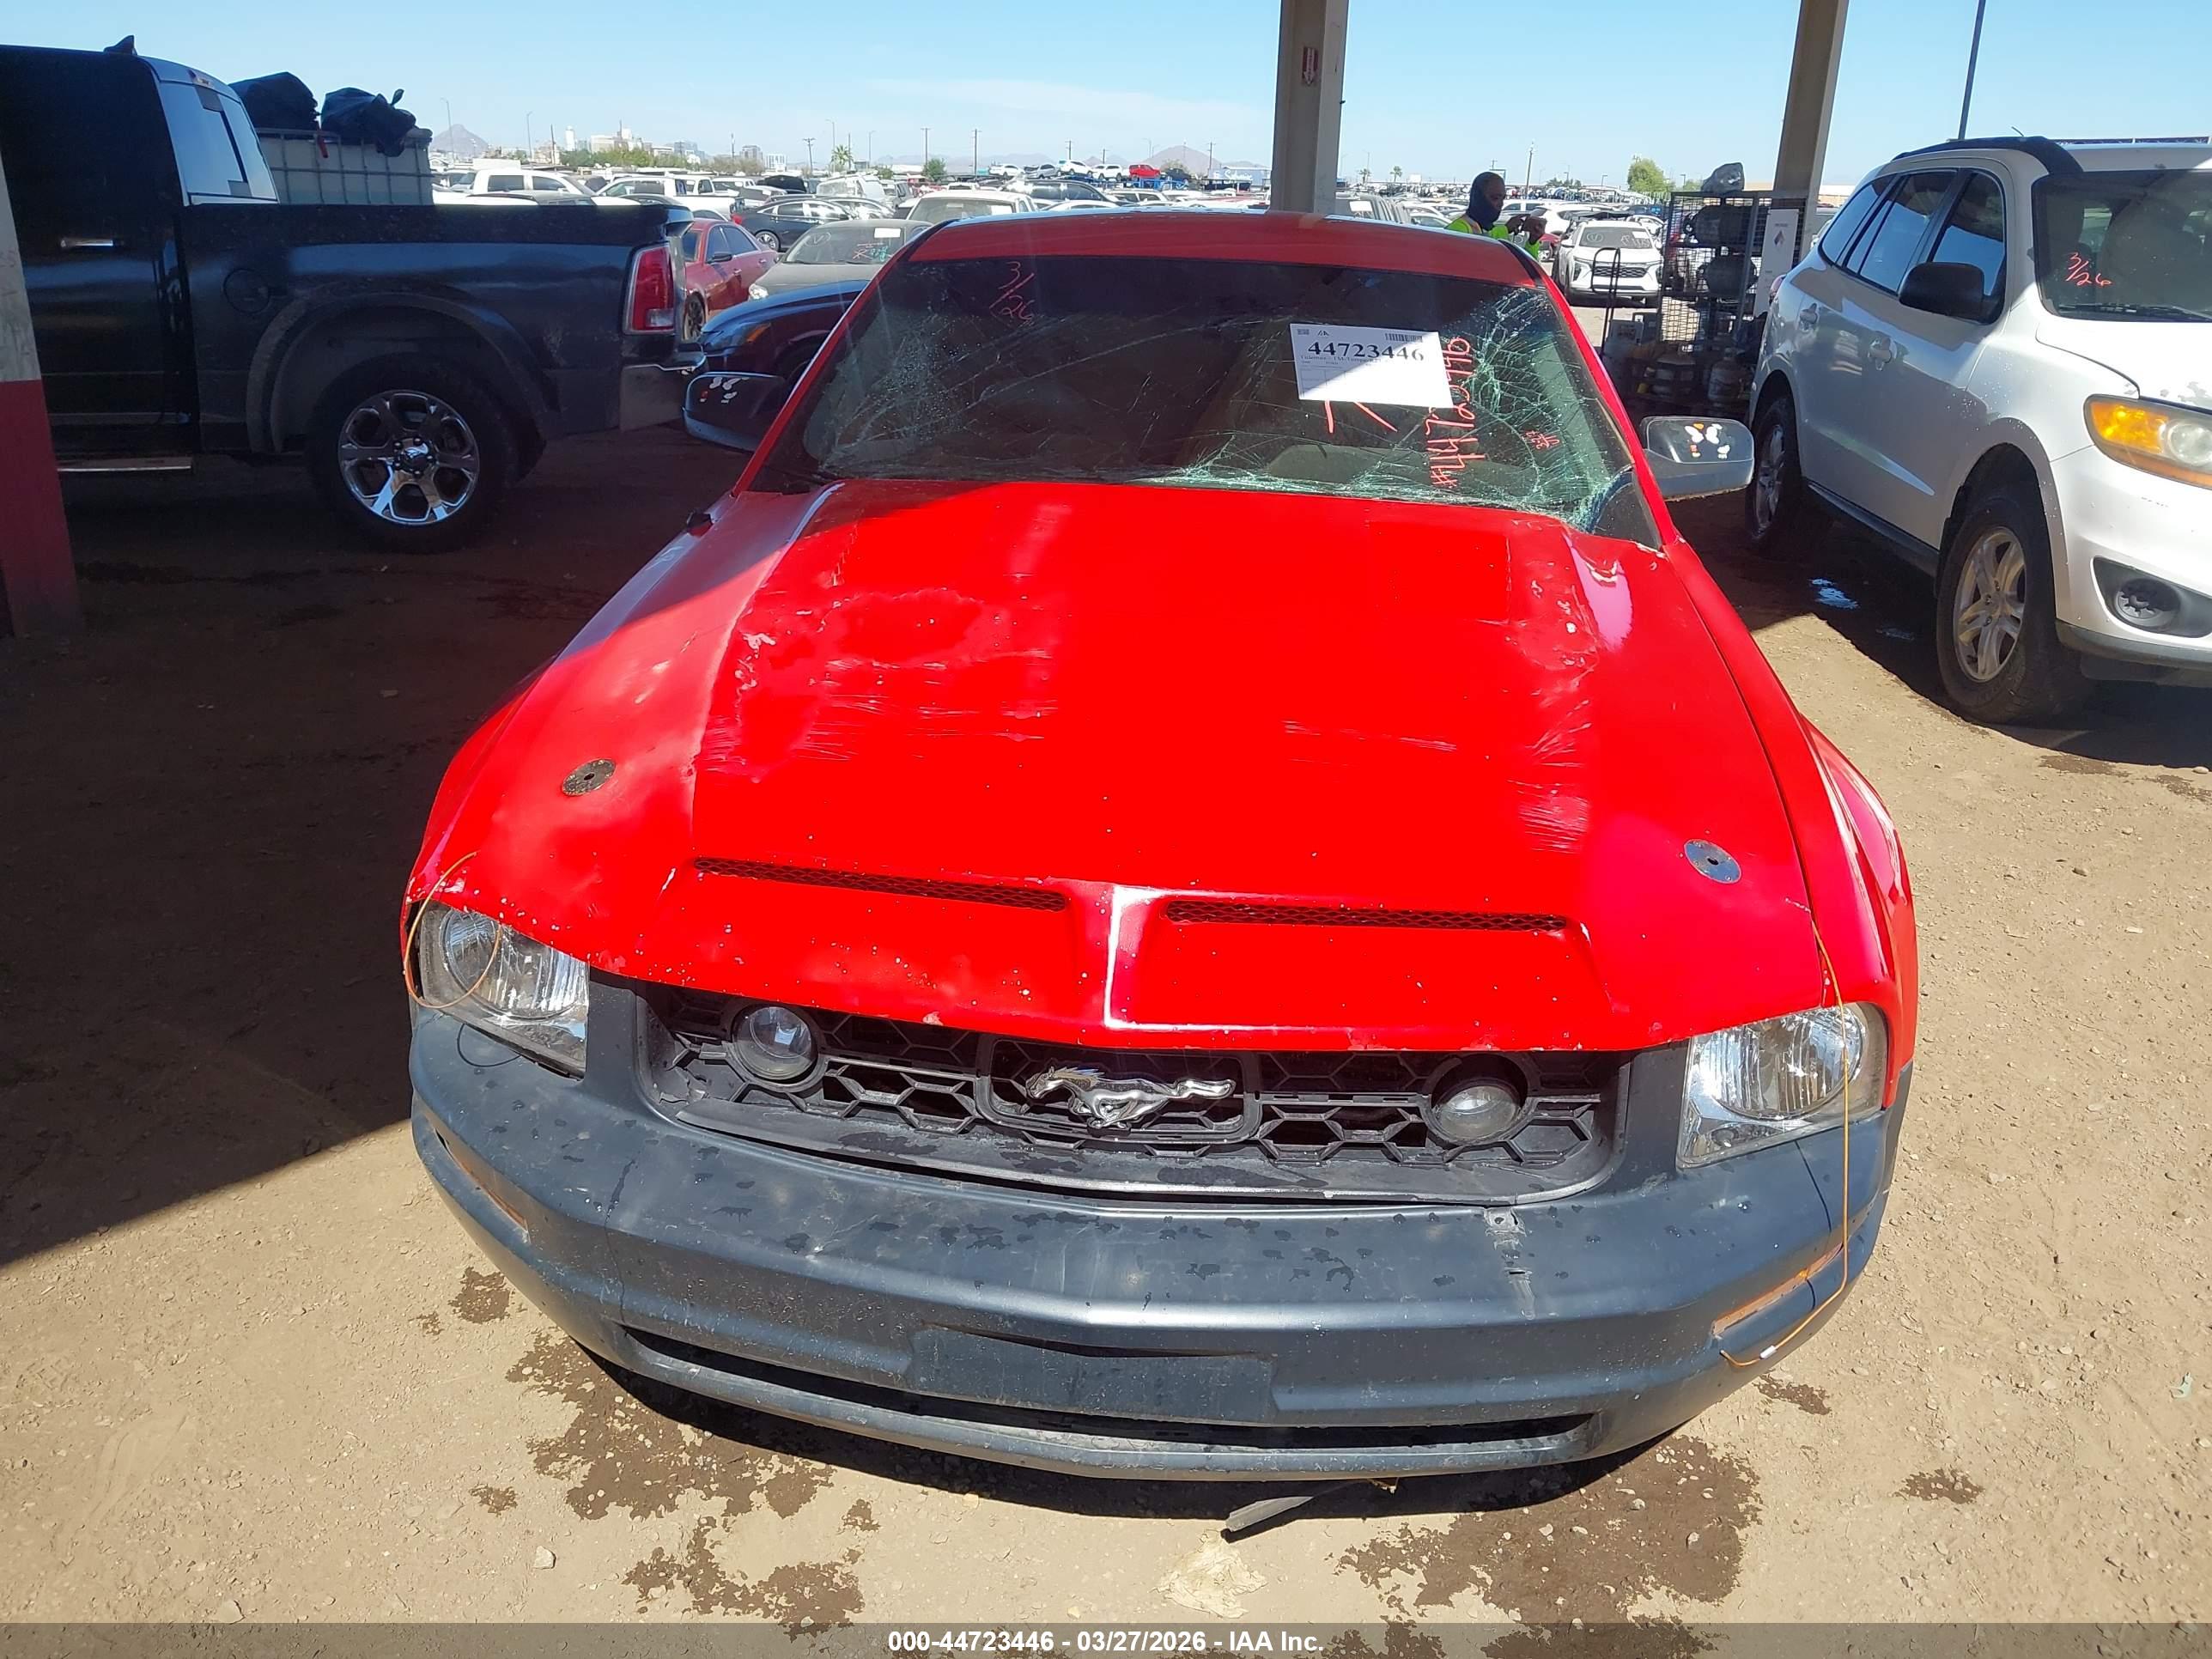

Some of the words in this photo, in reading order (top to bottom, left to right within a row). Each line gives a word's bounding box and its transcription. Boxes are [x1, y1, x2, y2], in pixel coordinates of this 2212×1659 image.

[2065, 252, 2112, 286] 3/26
[988, 260, 1035, 320] 3/26
[1308, 341, 1425, 362] 44723446
